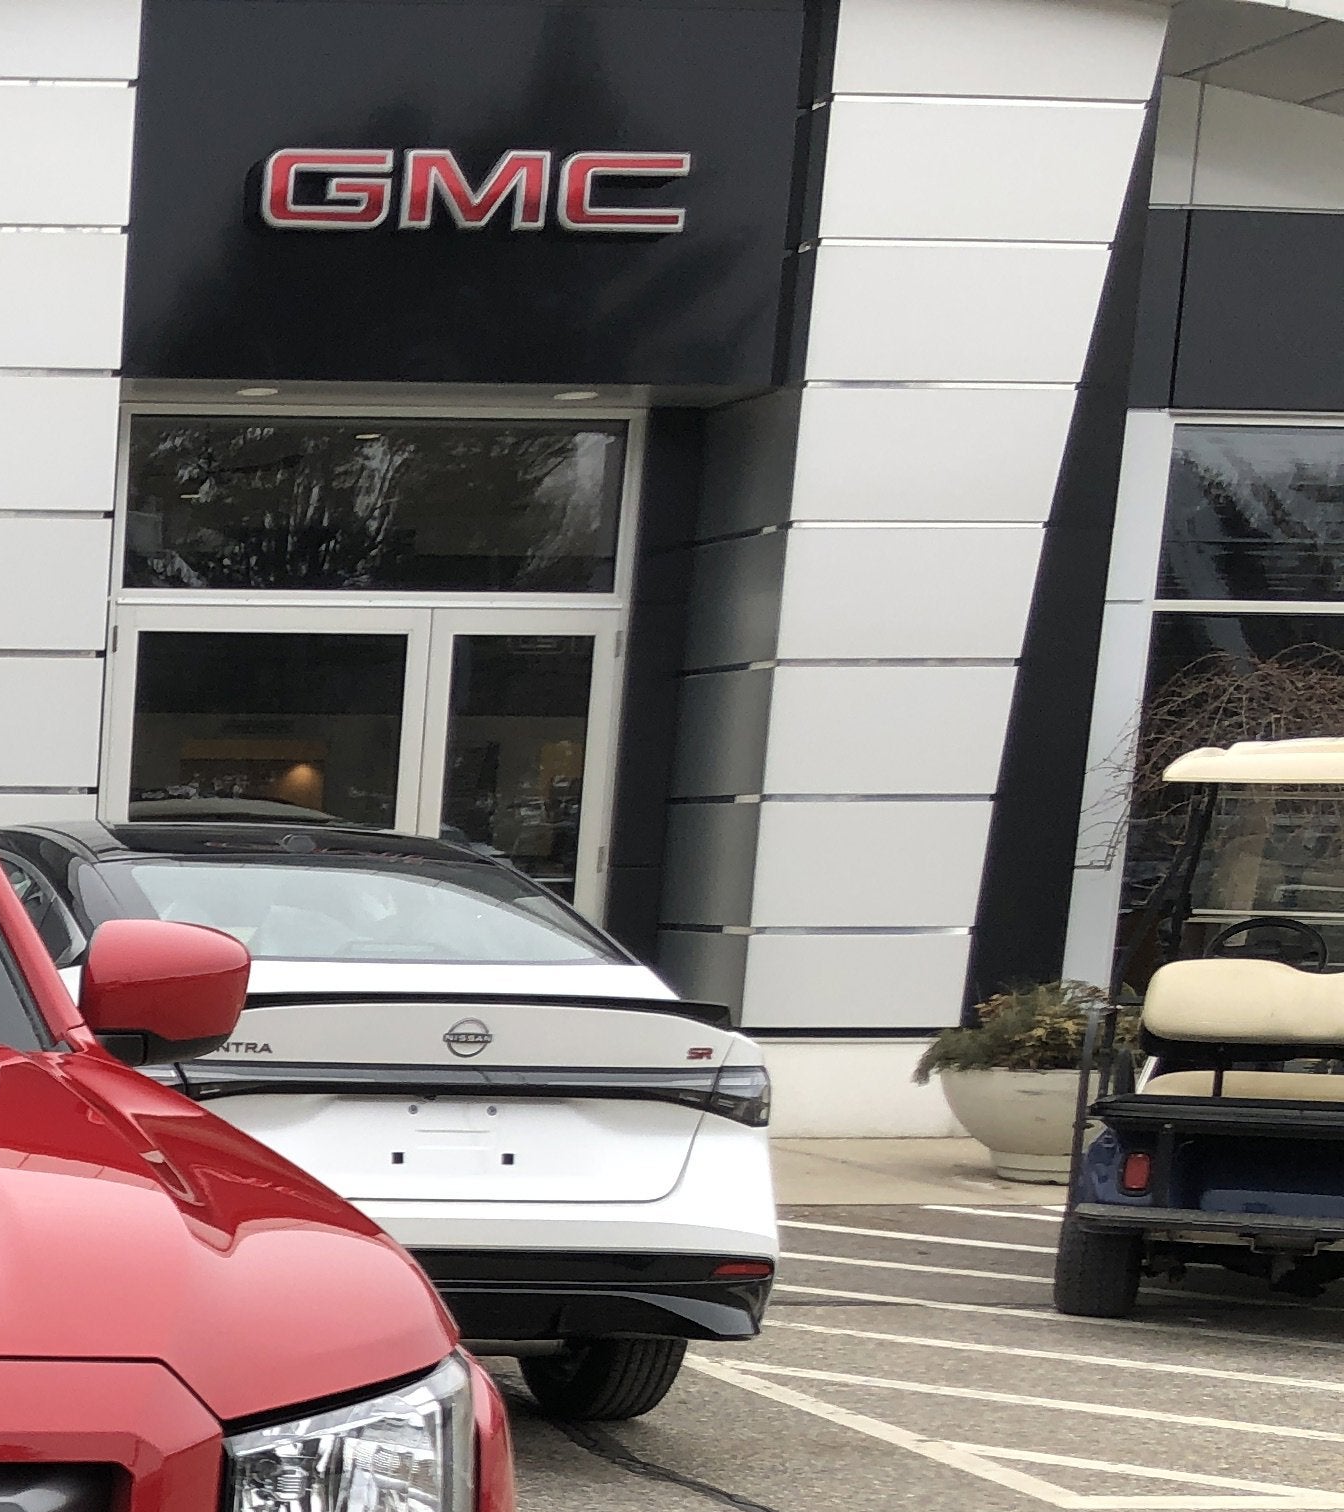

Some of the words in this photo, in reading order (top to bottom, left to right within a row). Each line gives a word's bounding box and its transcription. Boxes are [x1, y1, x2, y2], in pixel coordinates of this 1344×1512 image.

[261, 147, 692, 233] GMC
[216, 1042, 273, 1054] NTRA
[686, 1047, 714, 1060] SR
